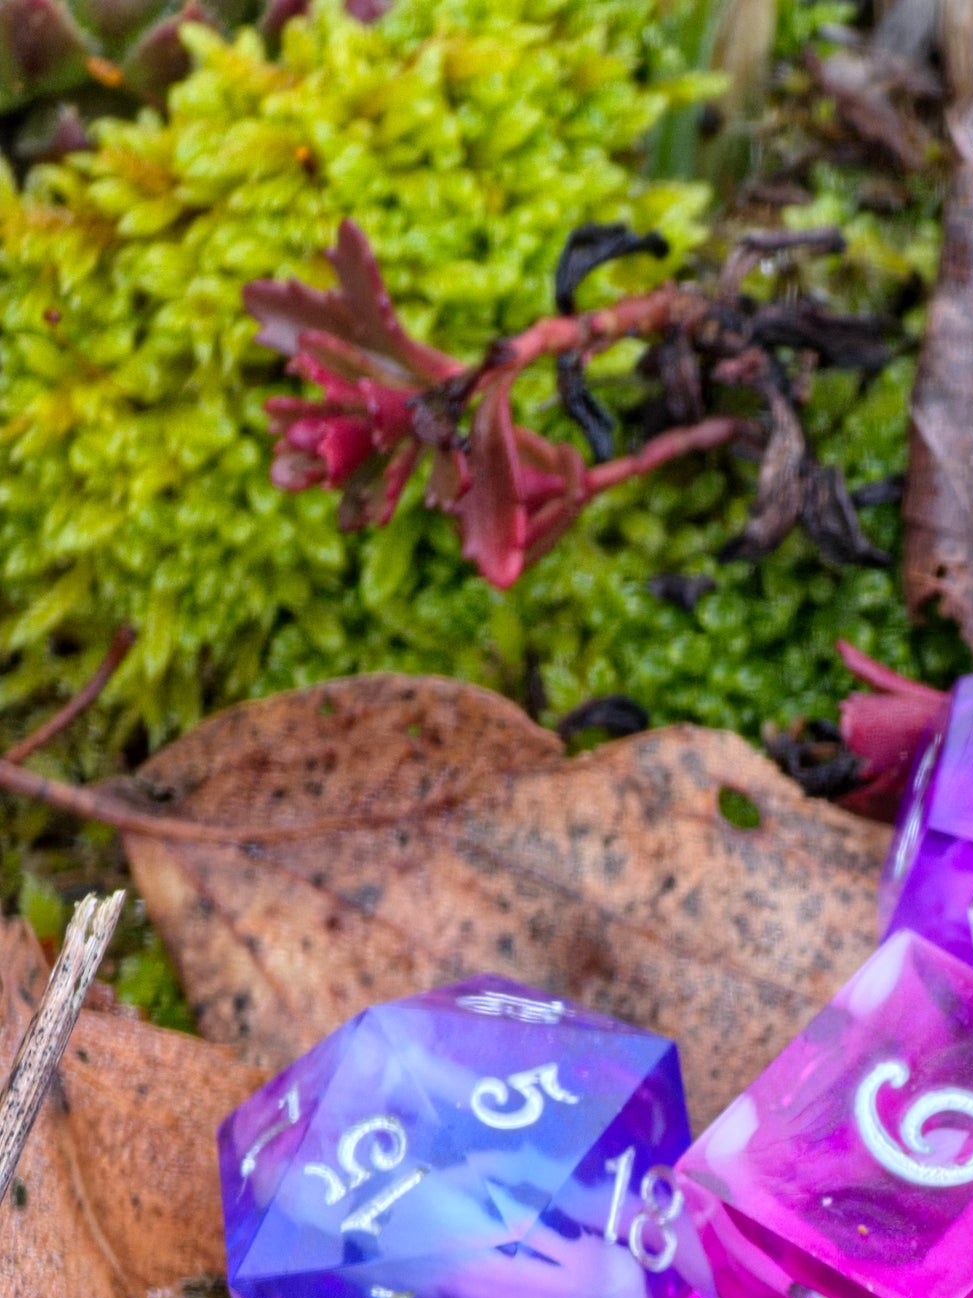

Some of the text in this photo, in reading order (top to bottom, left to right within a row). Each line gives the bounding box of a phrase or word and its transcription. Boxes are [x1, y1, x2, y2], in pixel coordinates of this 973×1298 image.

[471, 1063, 578, 1129] 5
[304, 1116, 430, 1234] 15
[604, 1147, 683, 1272] 18
